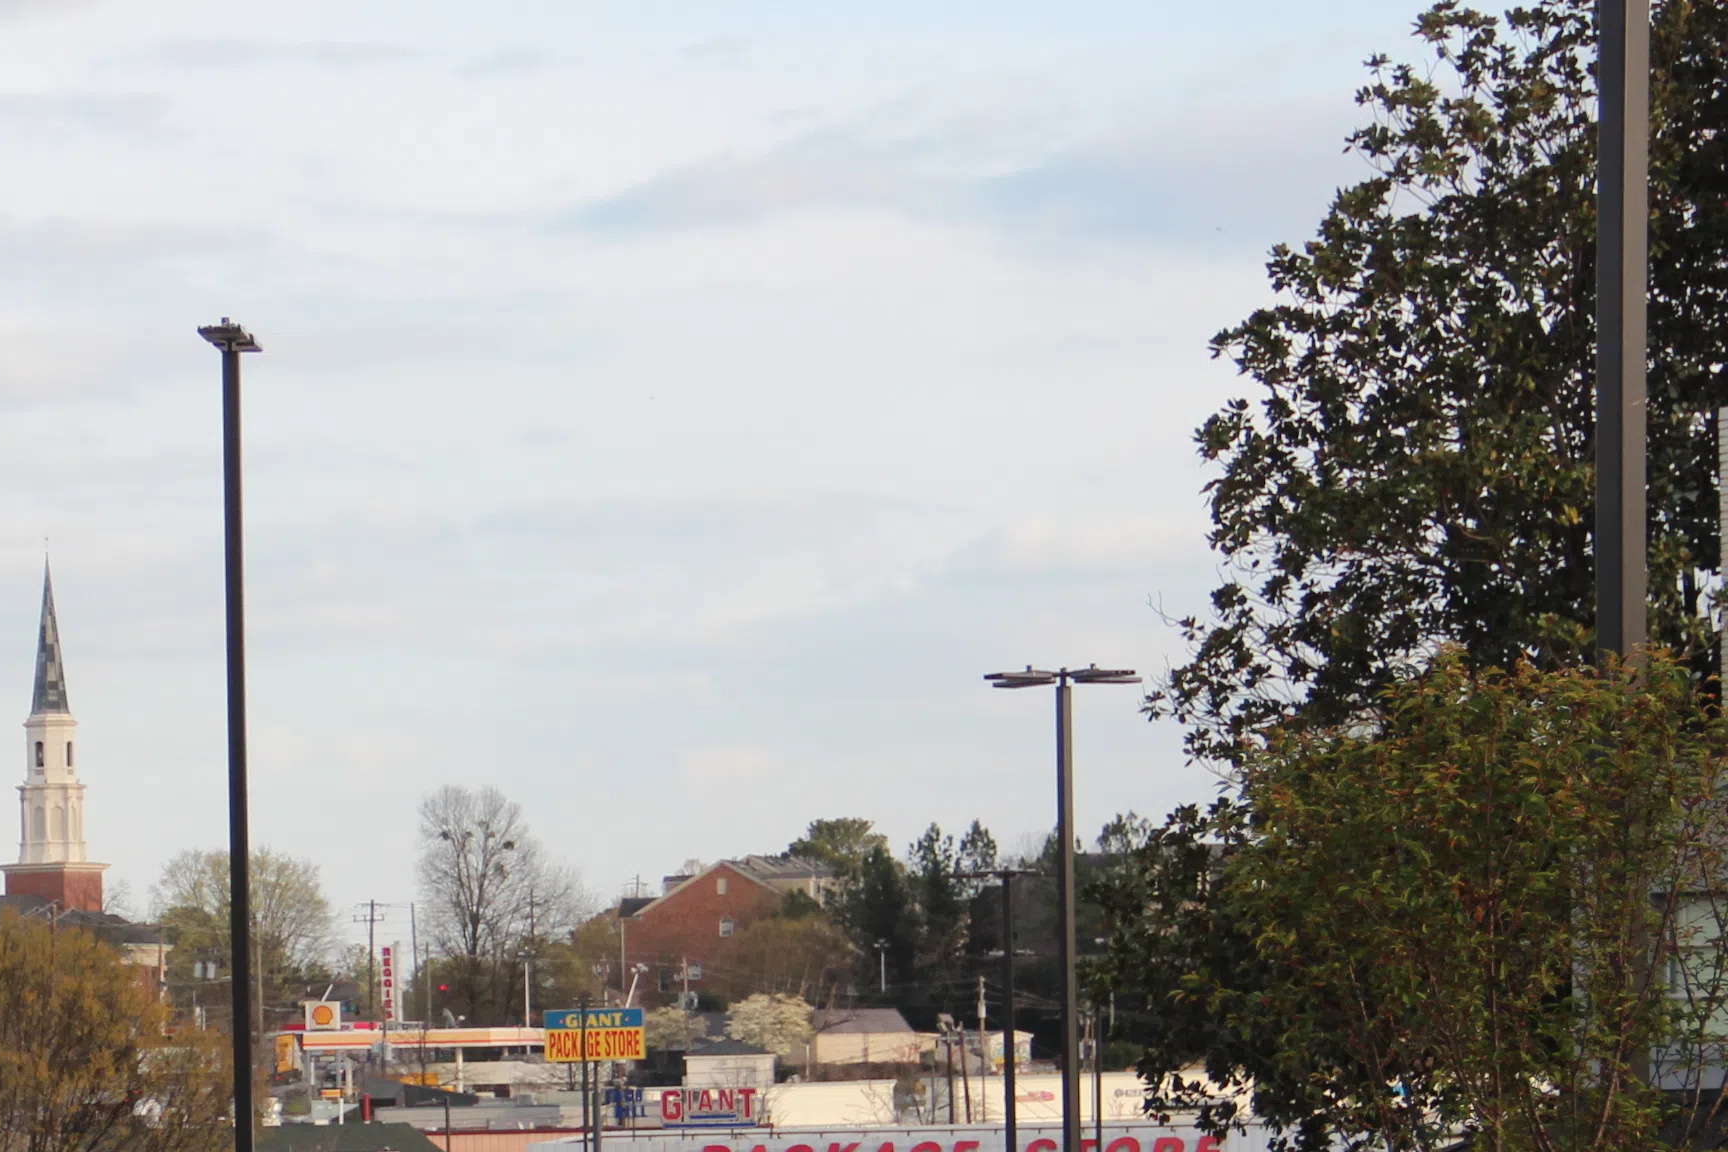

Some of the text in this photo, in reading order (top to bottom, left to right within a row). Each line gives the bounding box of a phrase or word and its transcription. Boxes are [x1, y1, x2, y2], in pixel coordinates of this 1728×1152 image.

[565, 1012, 623, 1028] GIANT
[549, 1029, 640, 1058] PACKGE STORE
[661, 1088, 757, 1121] GIANT
